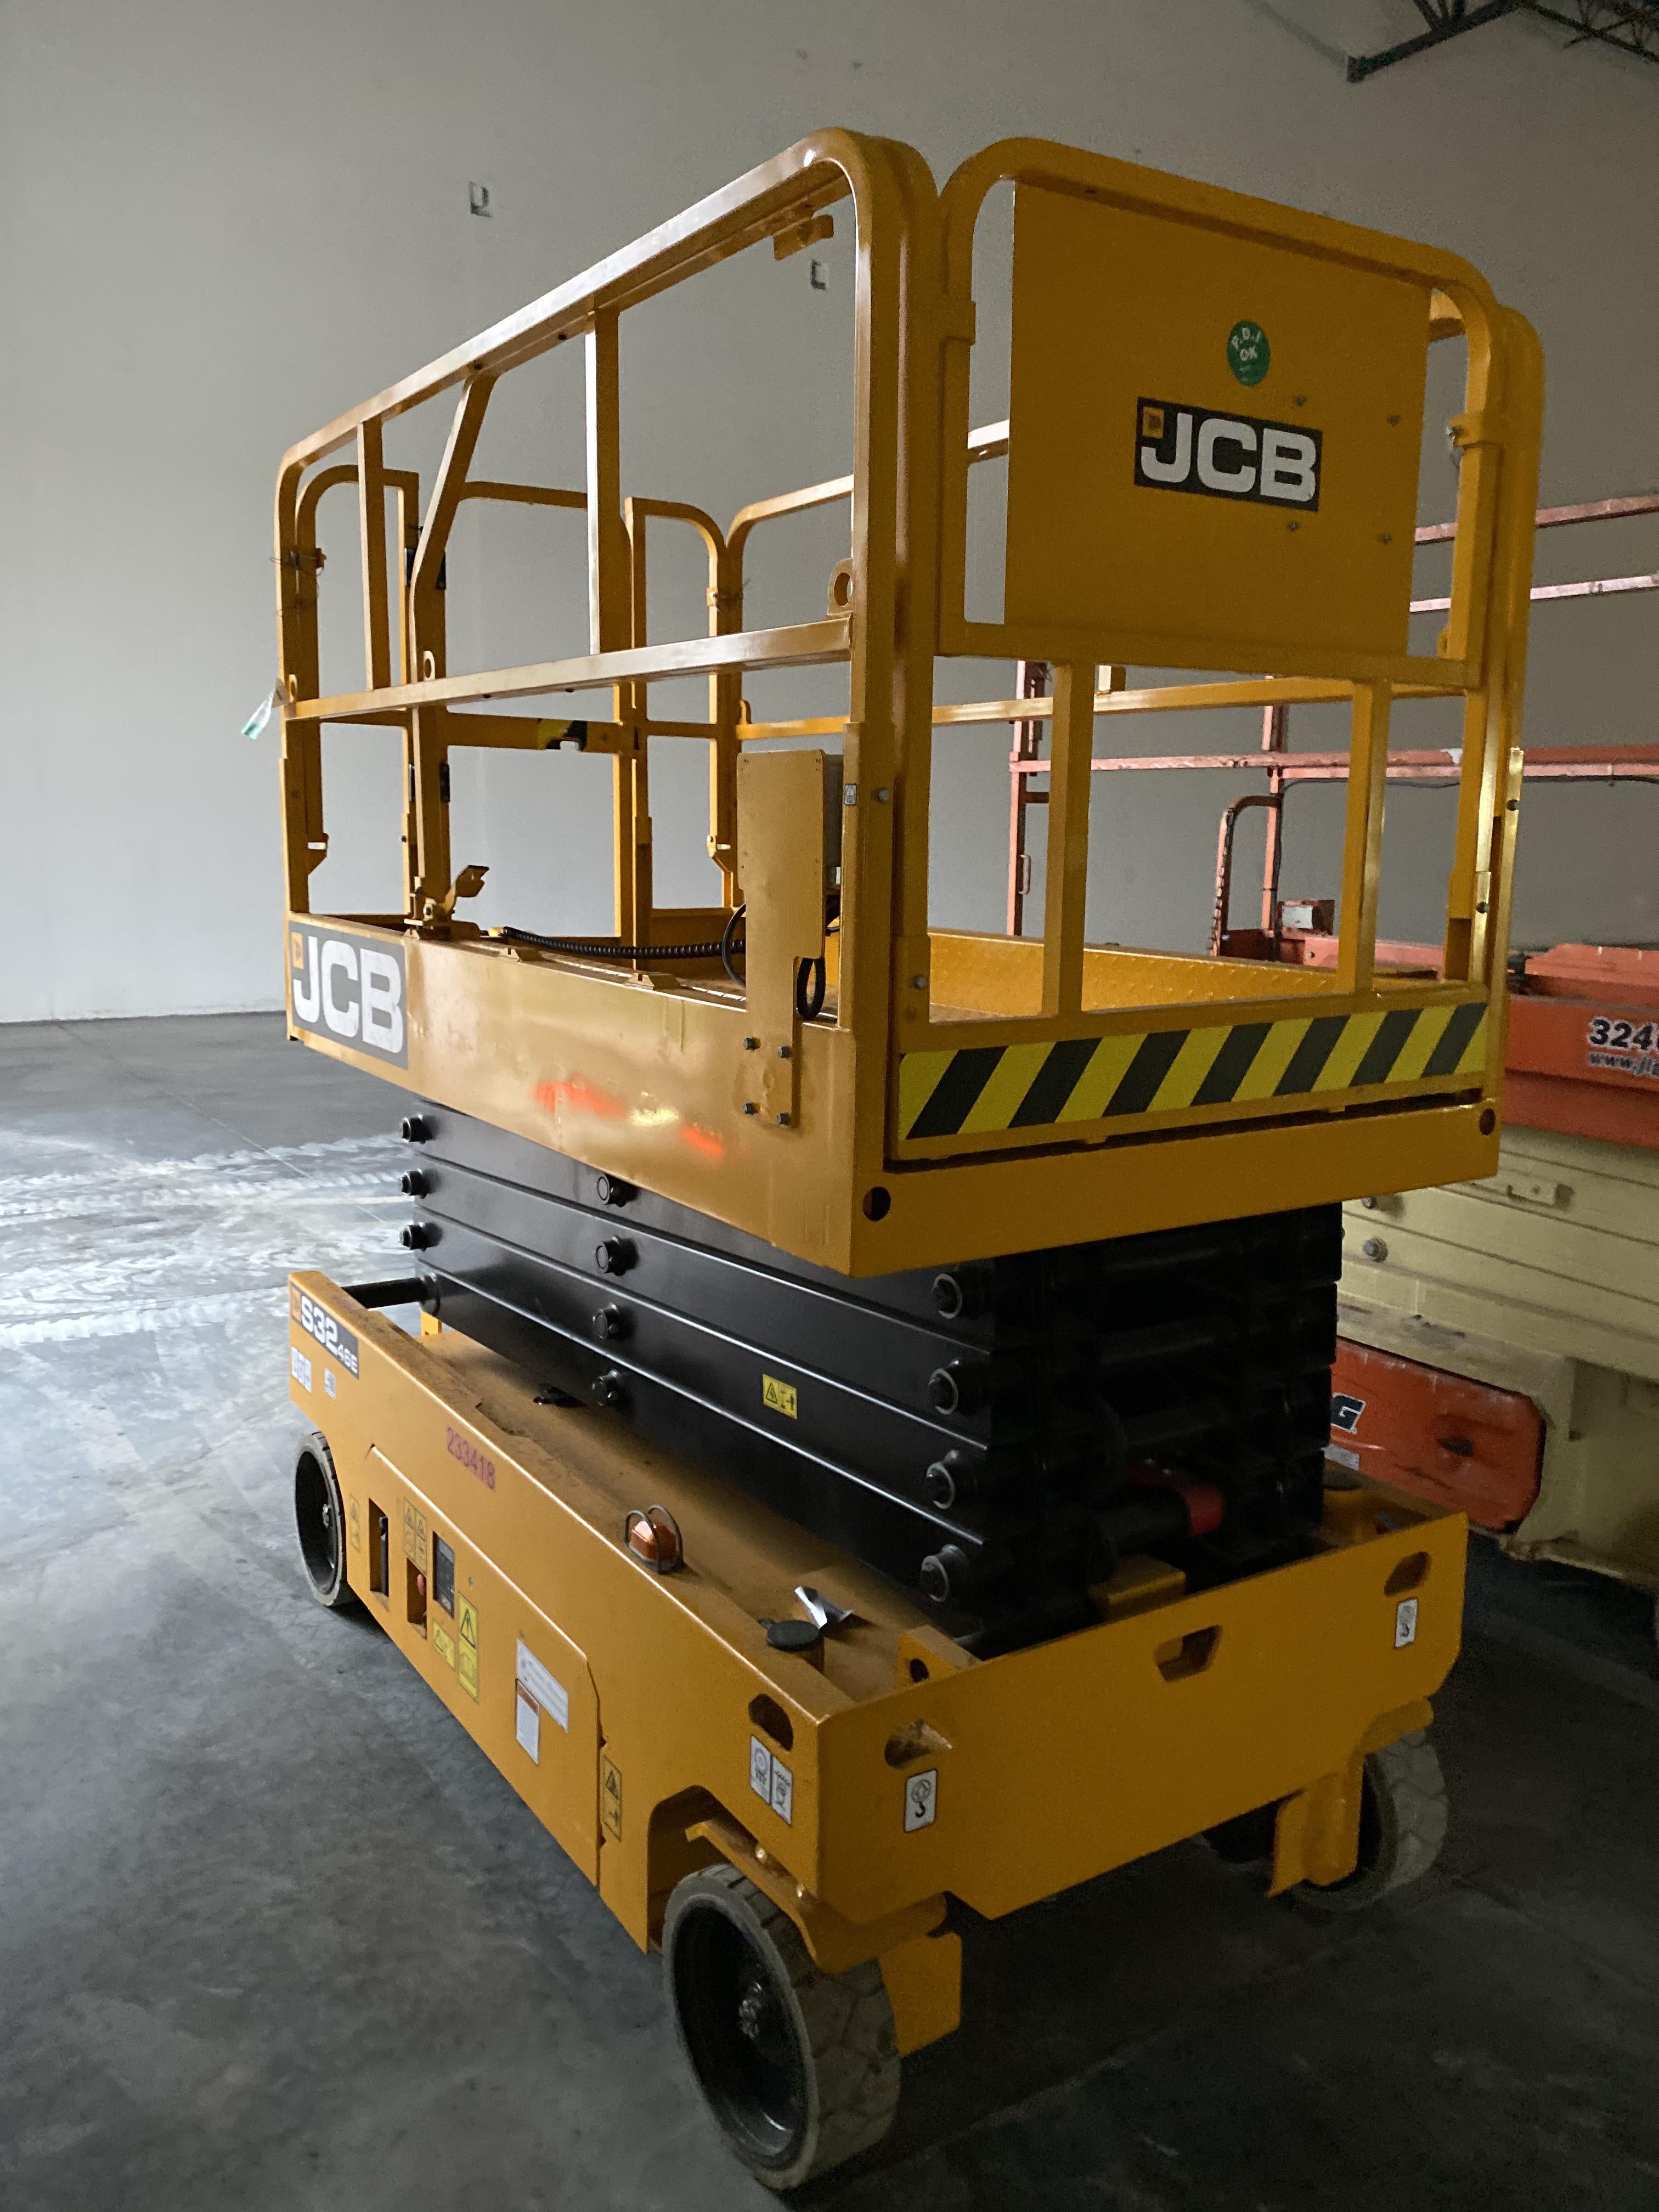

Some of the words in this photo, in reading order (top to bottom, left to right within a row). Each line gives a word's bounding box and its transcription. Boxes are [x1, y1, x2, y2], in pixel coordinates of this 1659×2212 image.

[1240, 346, 1258, 361] OK
[1141, 412, 1316, 502] JCB
[293, 935, 404, 1054] JCB
[1587, 1017, 1659, 1051] 324
